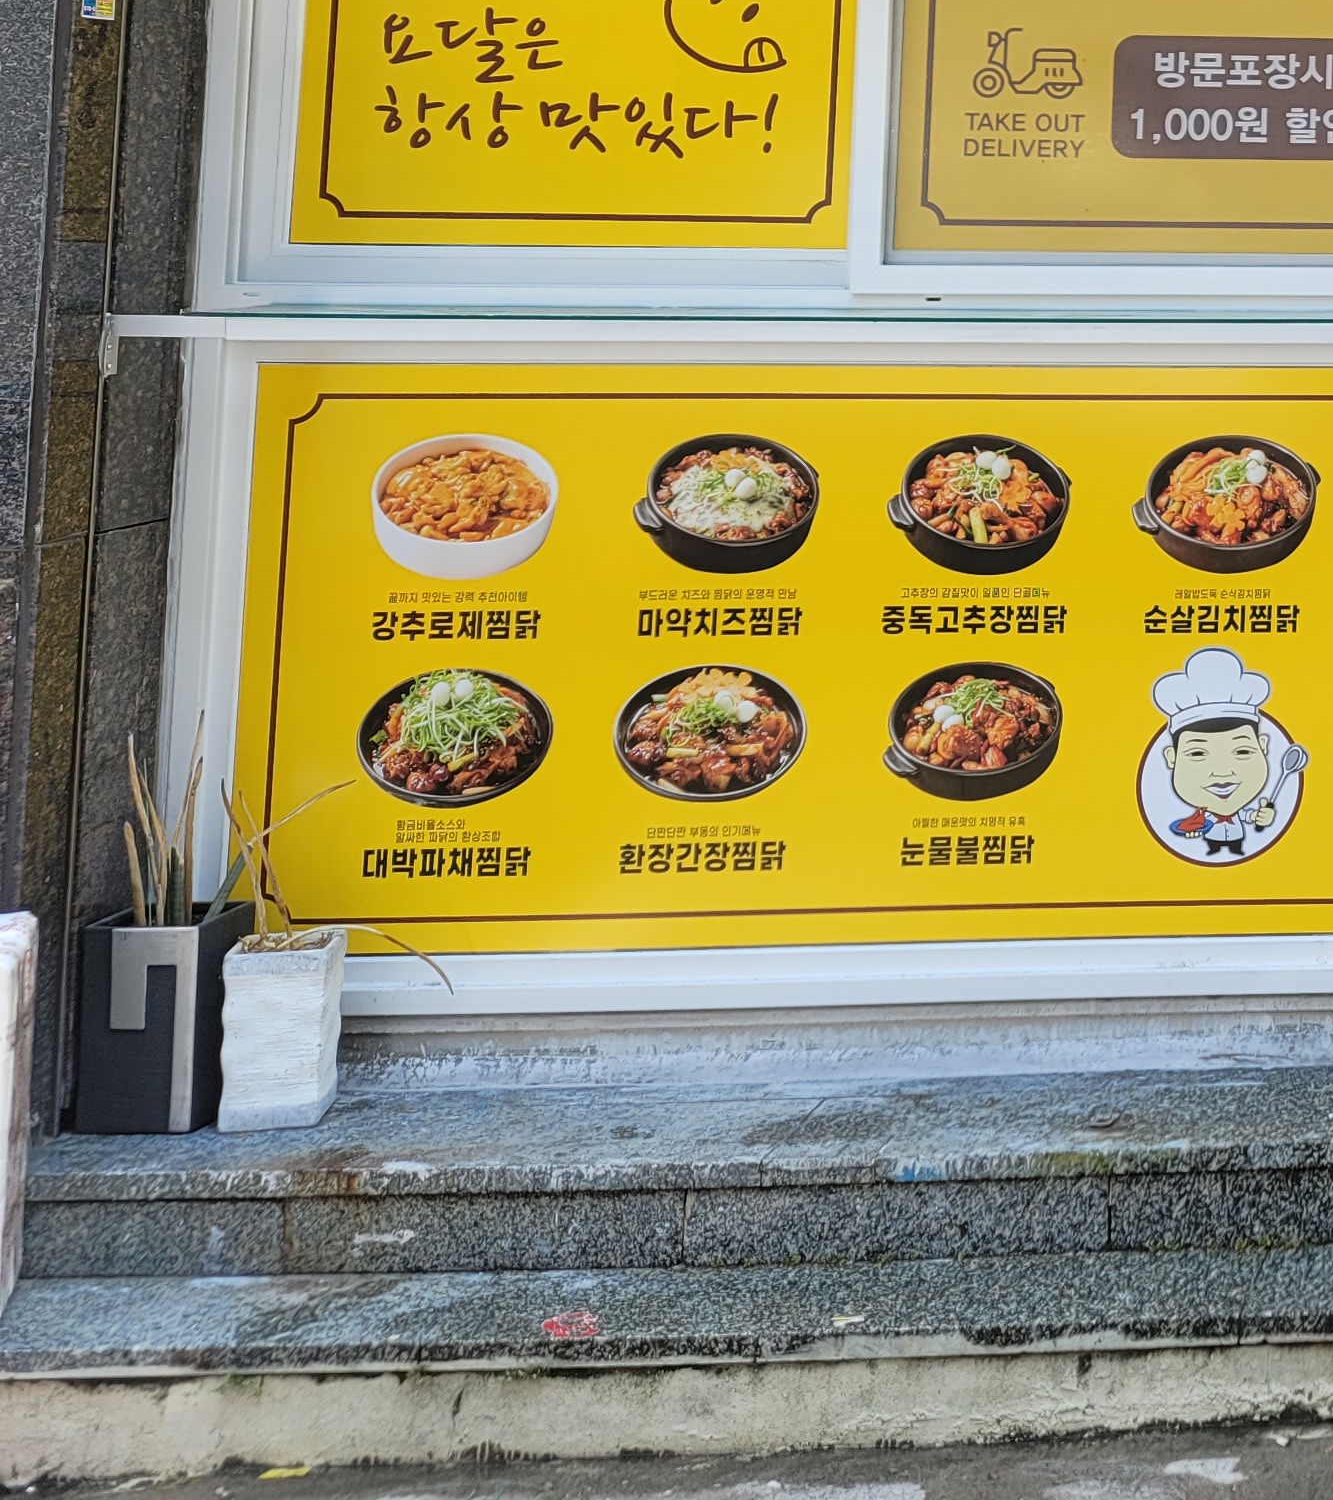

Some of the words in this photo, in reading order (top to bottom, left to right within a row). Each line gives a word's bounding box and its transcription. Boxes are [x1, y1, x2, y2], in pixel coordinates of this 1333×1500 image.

[383, 6, 564, 85] 요달은
[1154, 51, 1333, 90] 방문포장시
[374, 84, 523, 148] 항상
[539, 91, 779, 159] 맛있다!
[964, 112, 1027, 132] TAKE
[1035, 113, 1086, 133] OUT
[964, 139, 1084, 158] DELIVERY
[421, 591, 452, 604] 맛있는
[454, 591, 476, 604] 강력
[477, 590, 528, 603] 추천아이템
[638, 589, 678, 602] 부드러운
[680, 589, 711, 601] 치즈와
[712, 588, 743, 600] 찜닭의
[745, 587, 775, 600] 운명적
[777, 588, 797, 600] 만남
[900, 587, 939, 600] 고추장의
[982, 587, 1011, 599] 일품인
[1013, 587, 1050, 599] 단골메뉴
[372, 609, 542, 642] 강추로제찜닭
[637, 606, 803, 638] 마약치즈찜닭
[881, 604, 1068, 635] 중독고추장찜닭
[1143, 604, 1301, 634] 순살김치찜닭
[688, 825, 719, 838] 부동의
[721, 825, 761, 838] 인기메뉴
[941, 816, 977, 828] 매운맛의
[428, 831, 459, 844] 파닭의
[900, 834, 1035, 867] 눈물불찜닭
[362, 846, 532, 879] 대박파채찜닭
[618, 840, 787, 875] 환장간장찜닭
